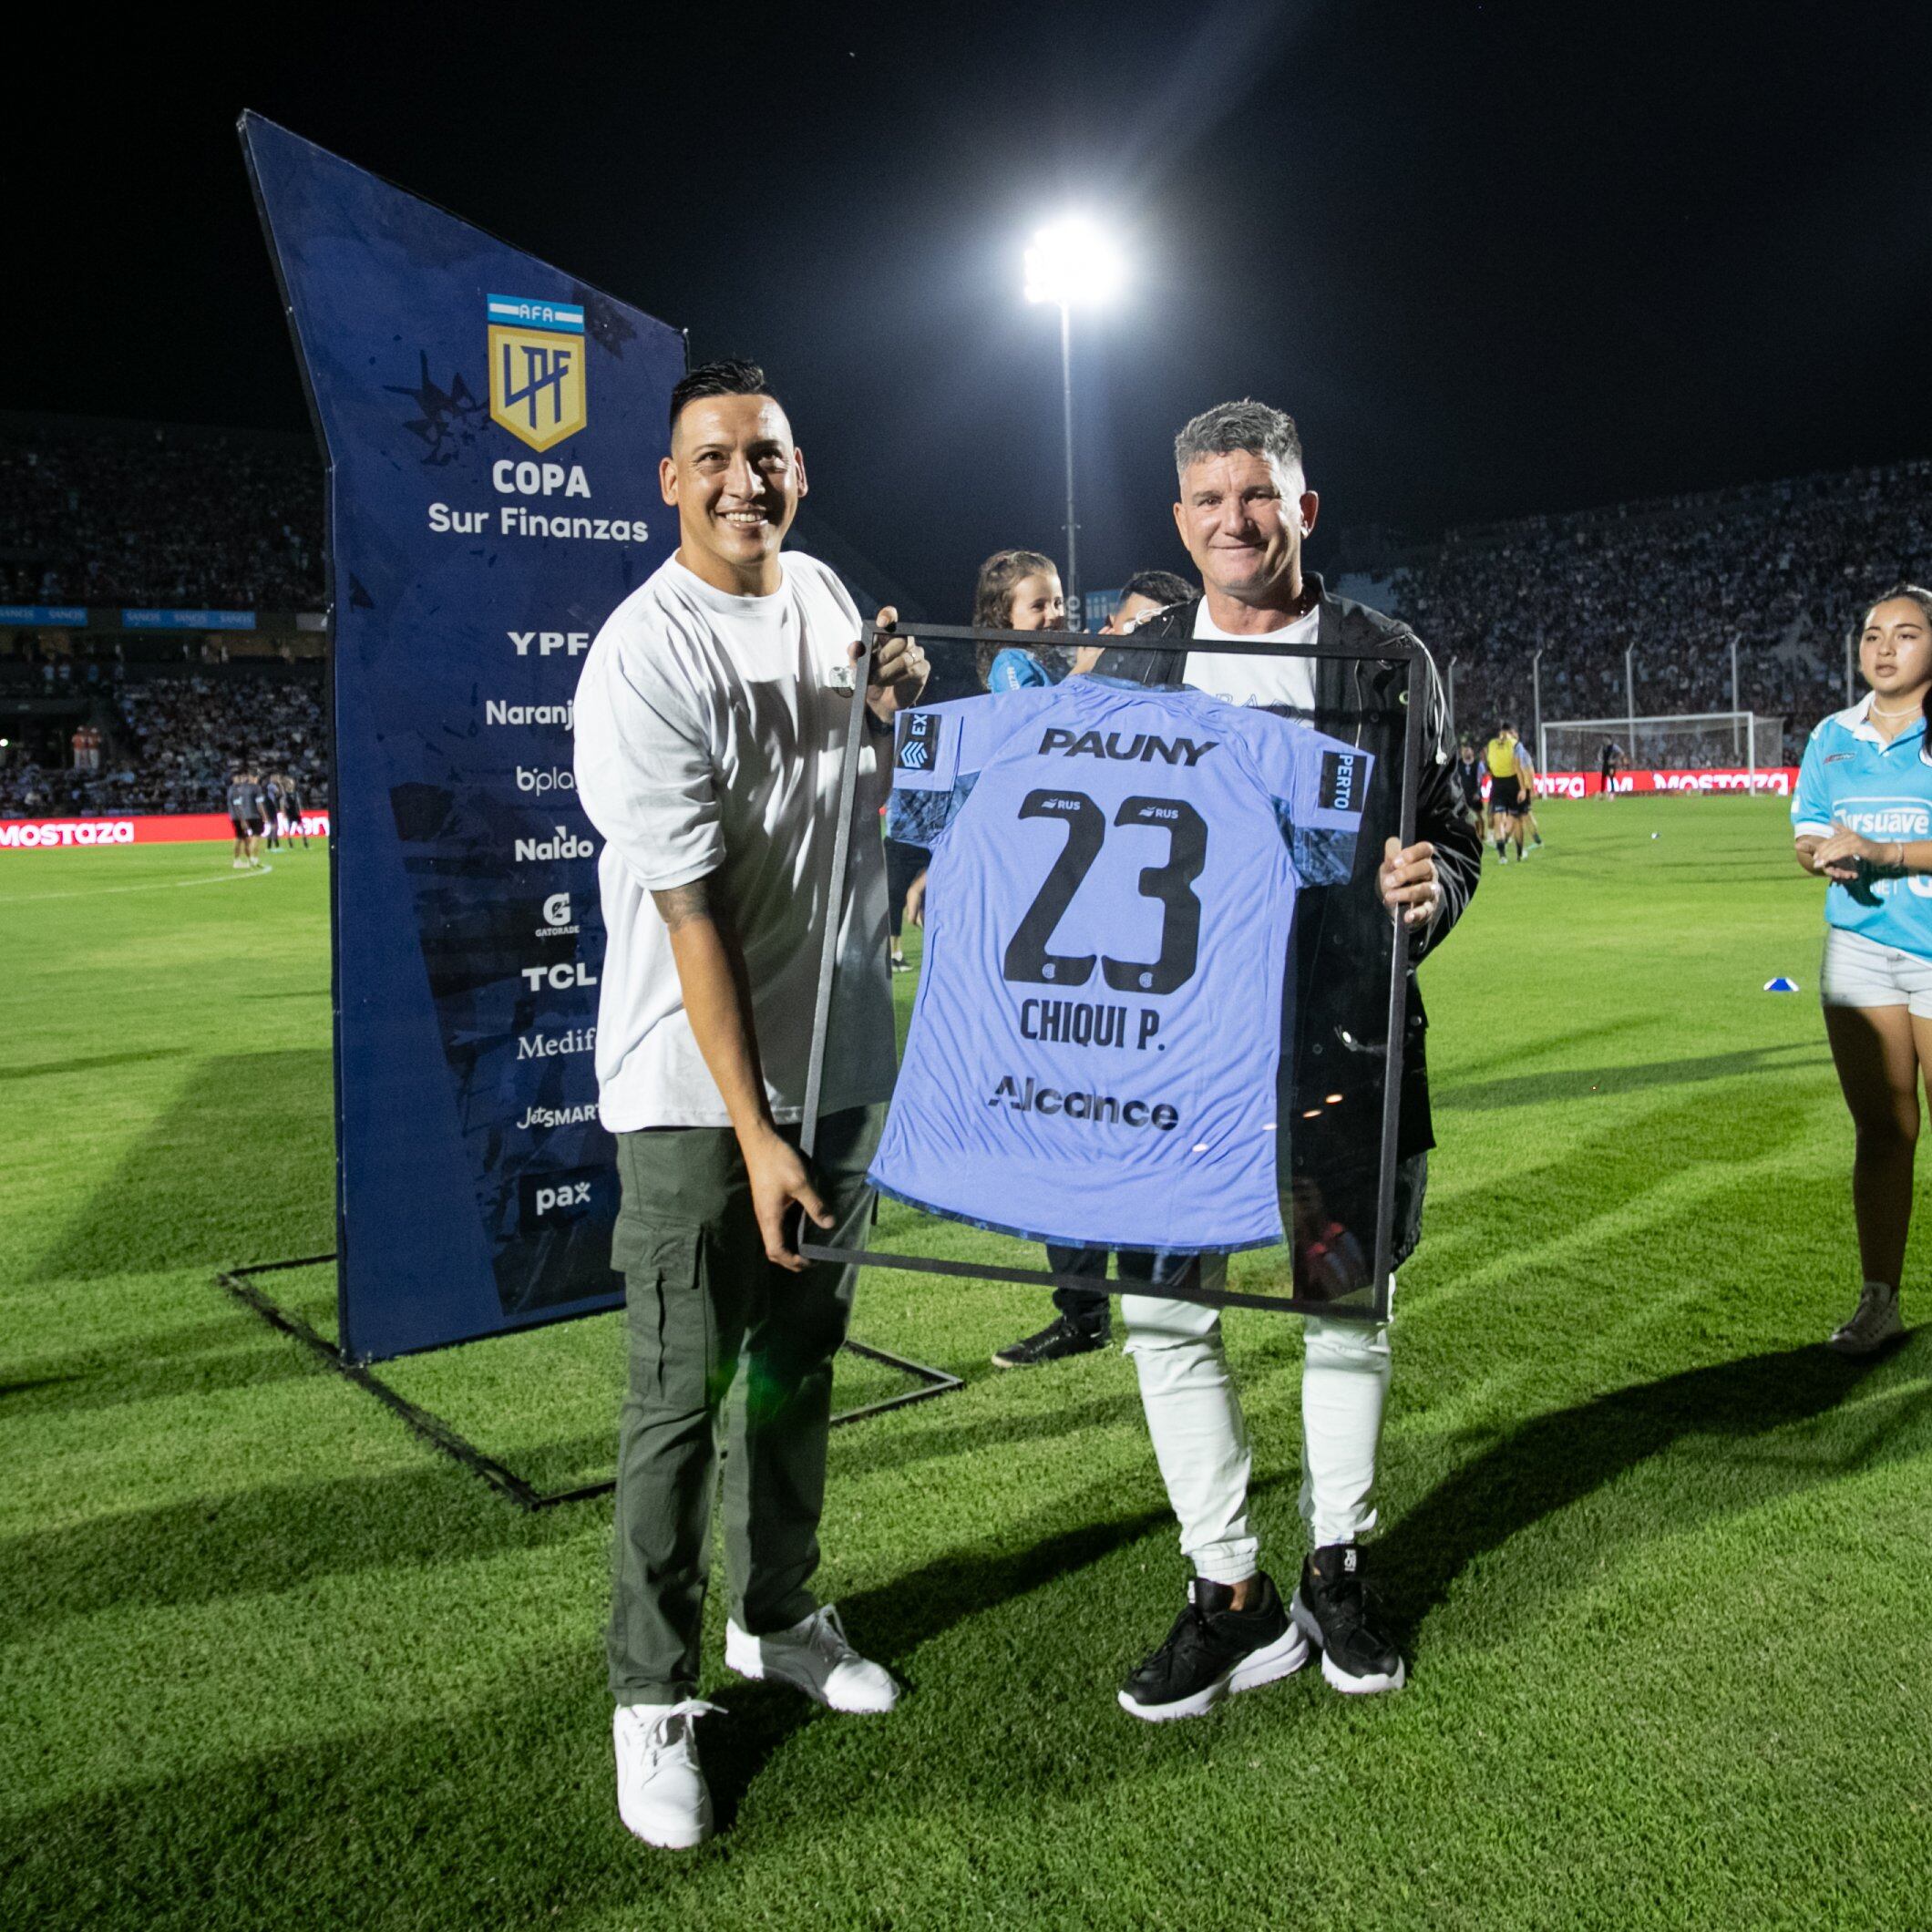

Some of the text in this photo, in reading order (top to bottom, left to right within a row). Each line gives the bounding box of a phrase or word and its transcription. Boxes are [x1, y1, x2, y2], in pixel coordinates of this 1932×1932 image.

[519, 303, 555, 322] AFA
[492, 459, 591, 498] COPA
[428, 502, 649, 542] Sur Finanzas
[507, 632, 590, 655] YPF
[911, 714, 928, 735] EX
[1038, 727, 1219, 767] PAUNY
[516, 766, 578, 796] bpla
[1333, 755, 1354, 809] PERTO
[1057, 799, 1081, 811] RUS
[1155, 807, 1179, 819] RUS
[515, 826, 594, 861] Naldo
[1002, 788, 1208, 995] 23
[535, 925, 581, 937] GATORADE
[521, 962, 598, 992] TCL
[1020, 998, 1166, 1051] CHIQUI P.
[988, 1075, 1179, 1131] Alcance
[536, 1181, 591, 1216] pax
